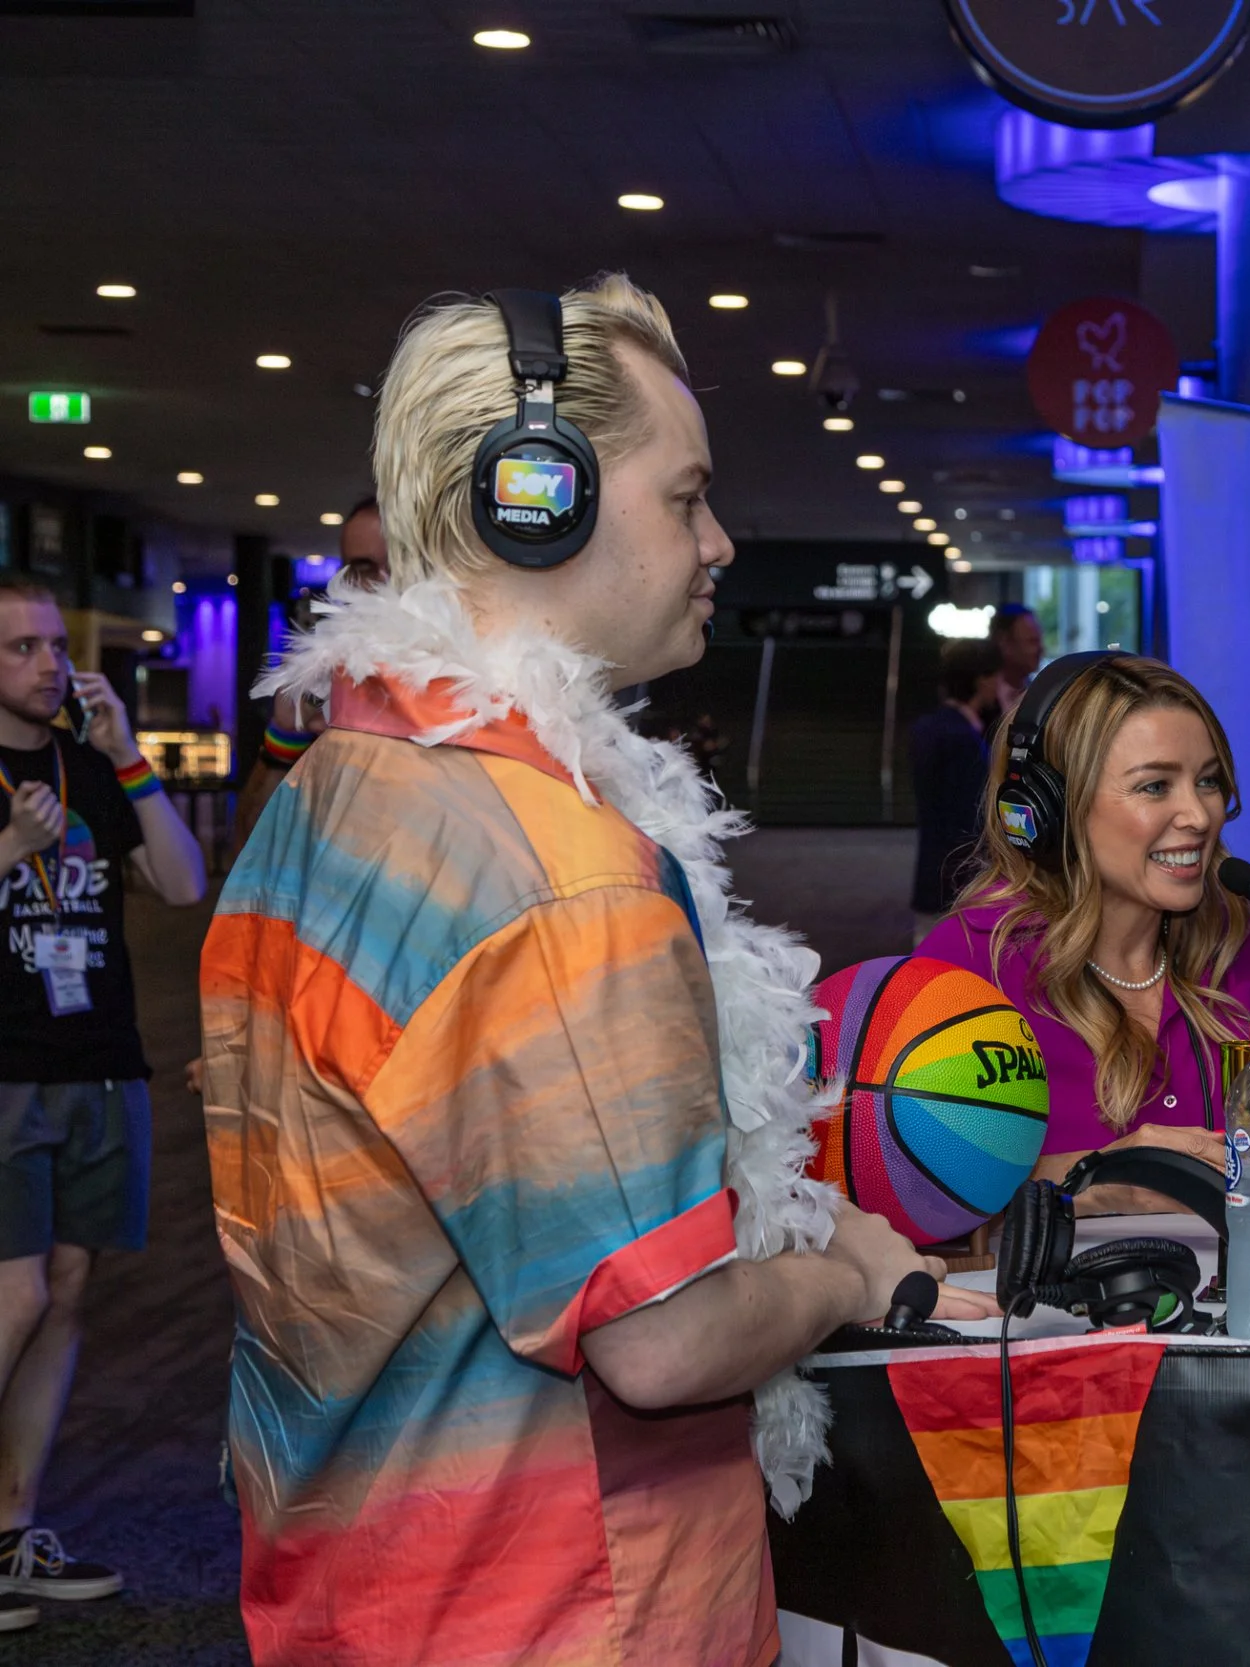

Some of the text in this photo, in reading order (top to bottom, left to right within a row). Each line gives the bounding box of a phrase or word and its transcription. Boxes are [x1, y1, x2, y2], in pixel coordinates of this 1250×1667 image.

[507, 471, 563, 497] JOY
[497, 508, 550, 525] MEDIA
[13, 901, 104, 917] BASKTBALL
